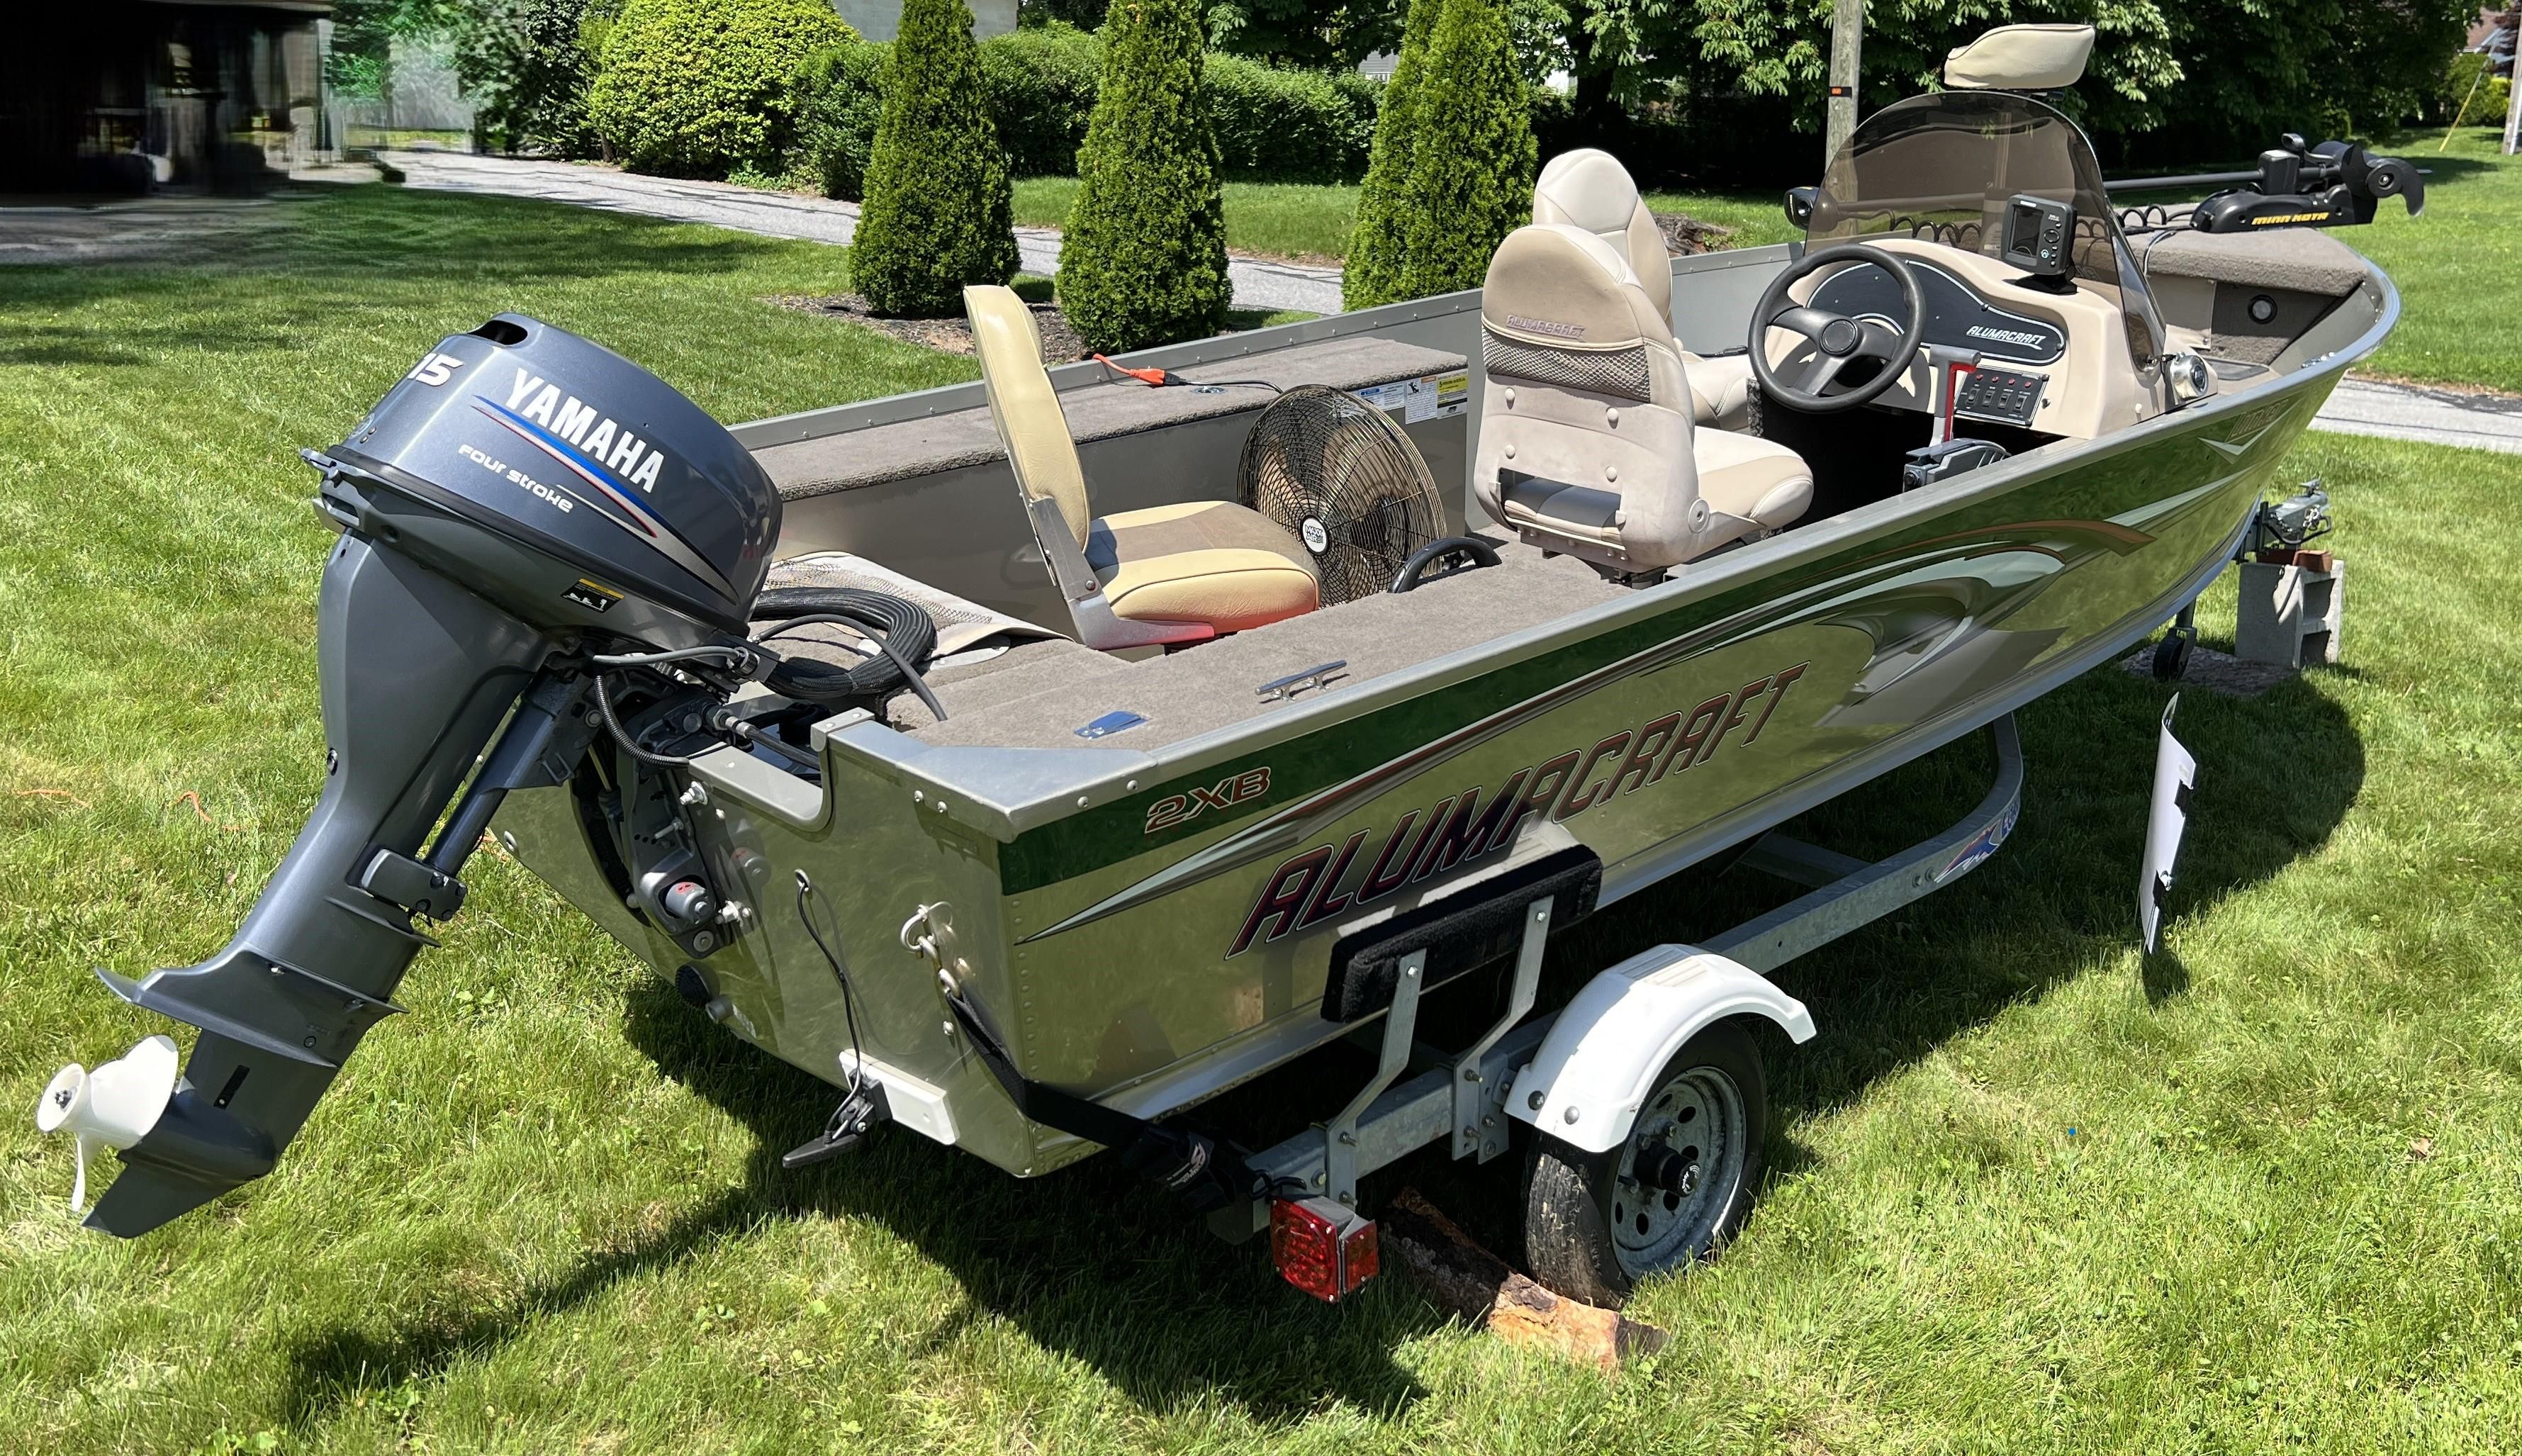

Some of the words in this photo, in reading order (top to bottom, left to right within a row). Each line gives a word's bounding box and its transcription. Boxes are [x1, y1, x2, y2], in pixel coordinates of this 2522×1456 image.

[1966, 325, 2046, 345] ALUMACRAFT
[408, 353, 464, 387] 15
[505, 367, 664, 493] YAMAHA
[1145, 766, 1271, 834] 2XB
[1224, 661, 1810, 961] ALUMACRAFT
